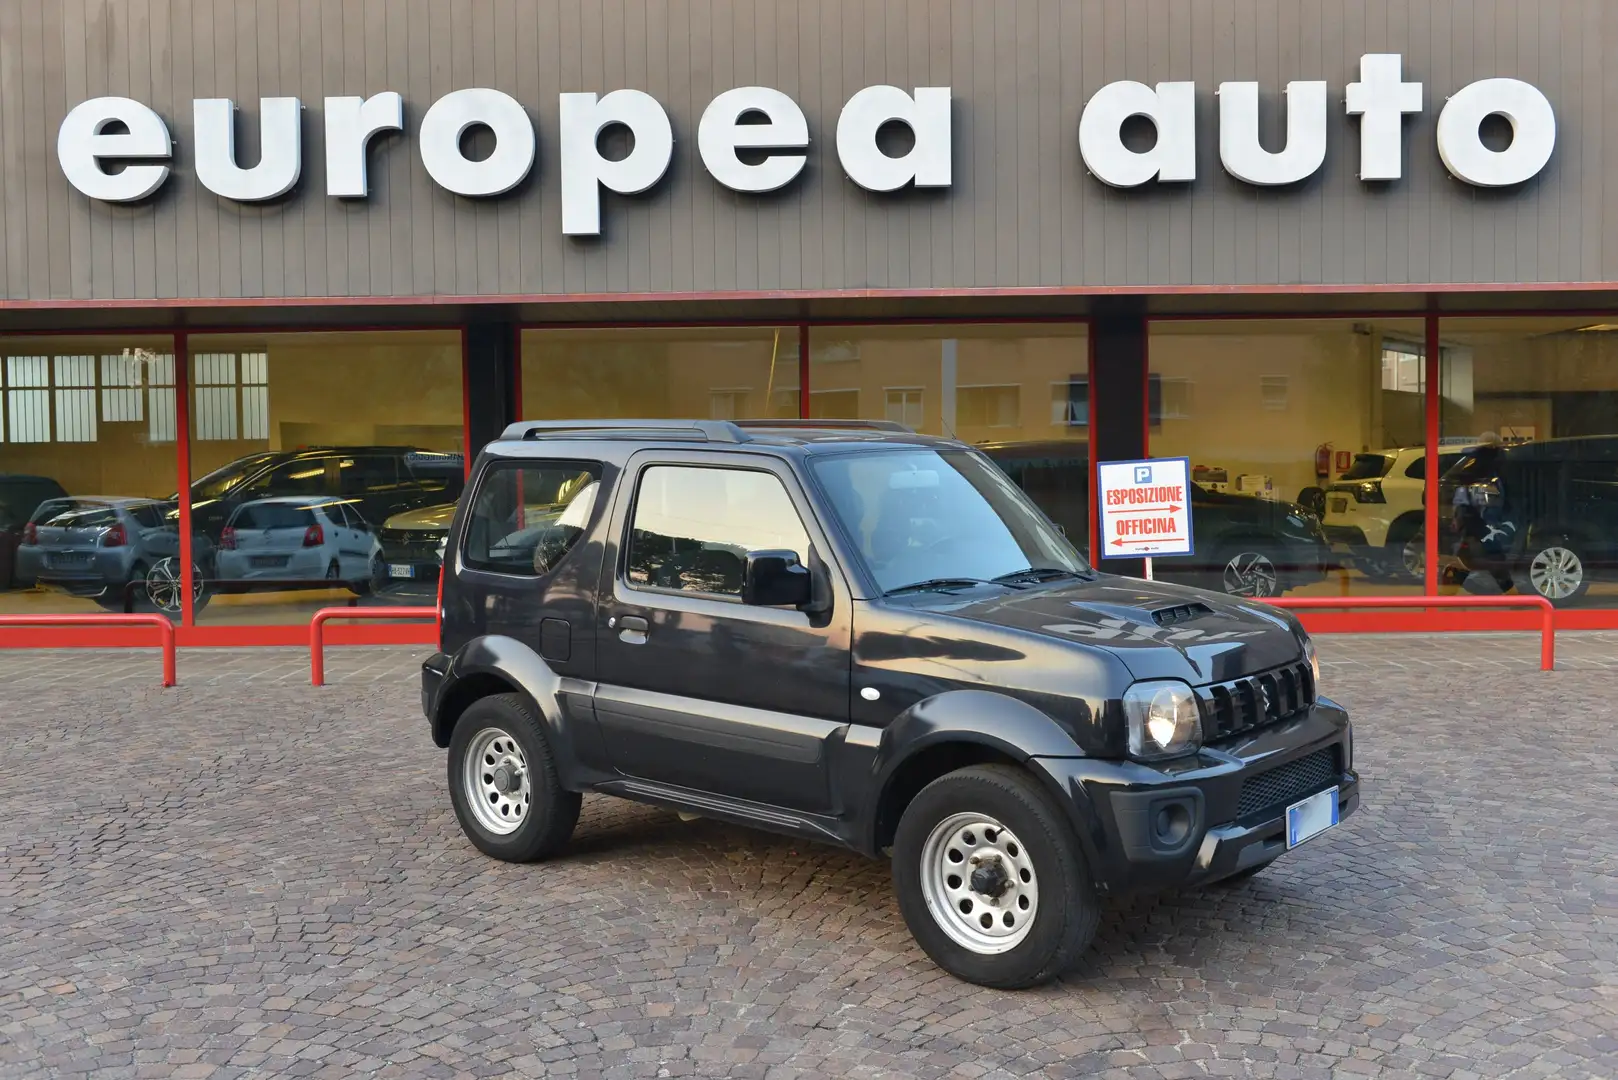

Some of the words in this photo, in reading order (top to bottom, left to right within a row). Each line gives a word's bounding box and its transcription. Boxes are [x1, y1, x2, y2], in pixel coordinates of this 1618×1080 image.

[57, 85, 952, 237] europea
[1078, 53, 1556, 188] auto
[1136, 468, 1150, 482] P
[1106, 486, 1183, 505] ESPOSIZIONE
[1116, 517, 1177, 536] OFFICINA
